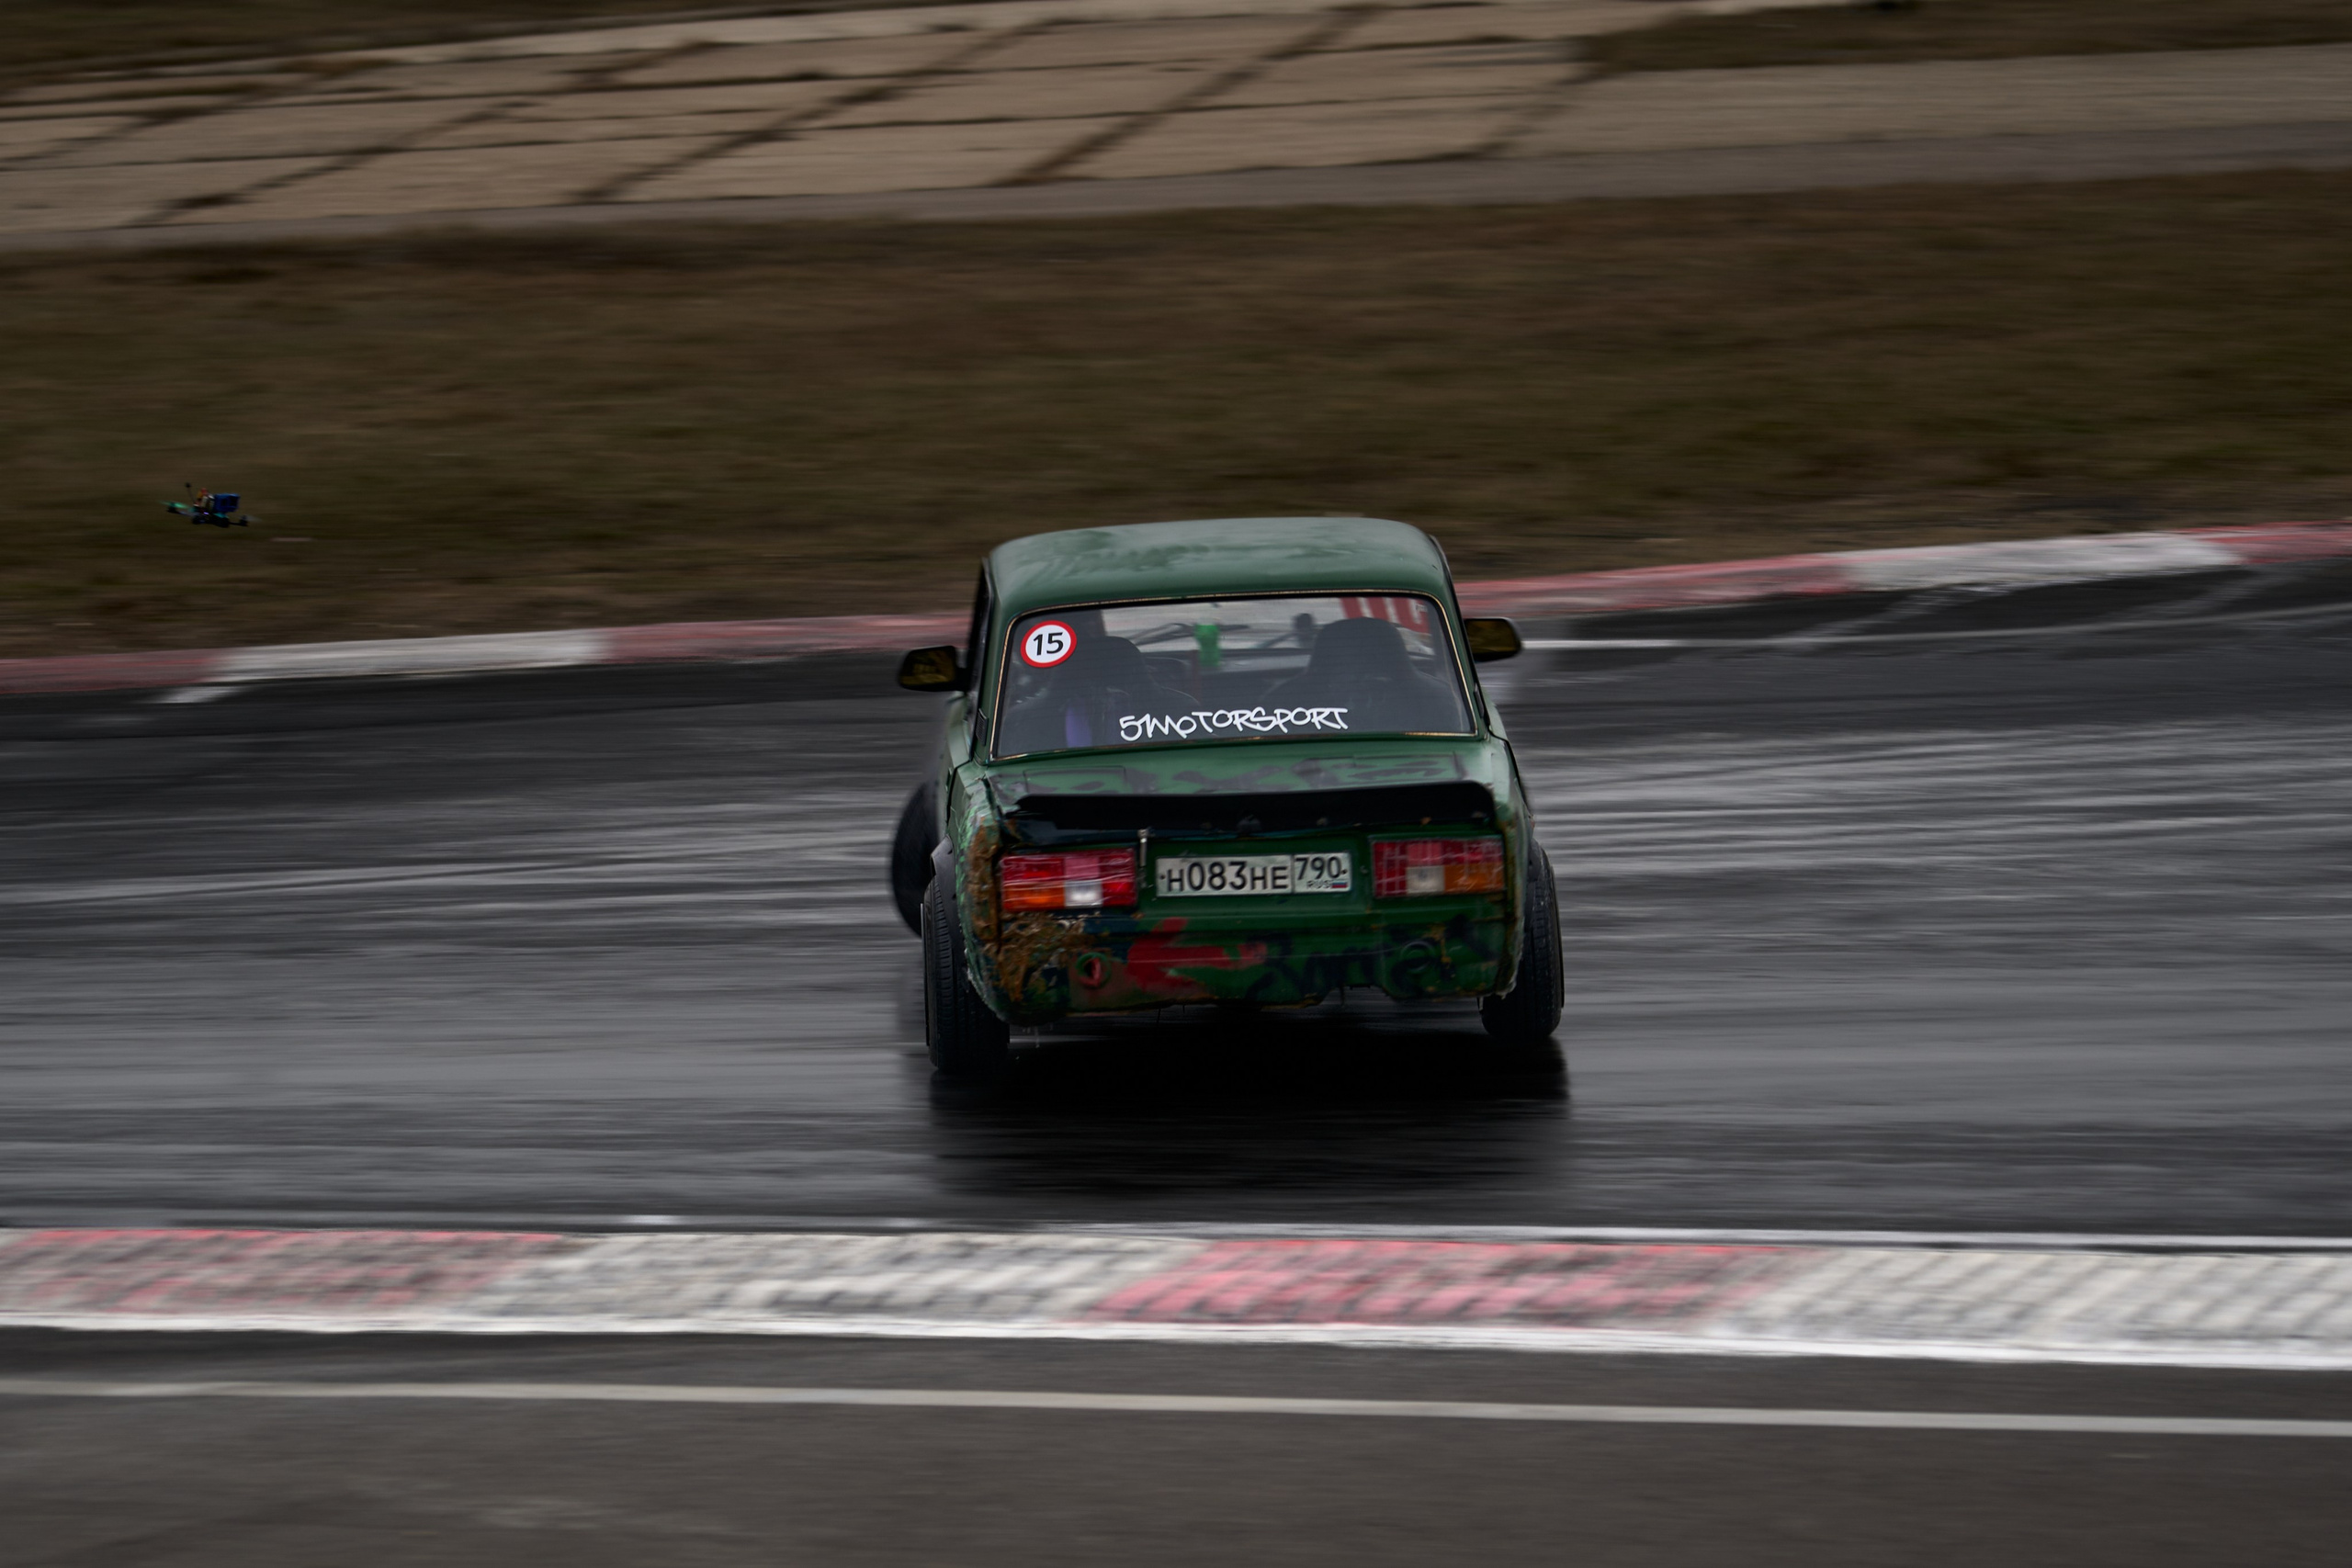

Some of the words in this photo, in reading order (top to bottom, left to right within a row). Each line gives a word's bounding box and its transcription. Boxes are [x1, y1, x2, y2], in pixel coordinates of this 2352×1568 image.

[1033, 632, 1064, 656] 15
[1167, 862, 1288, 892] H083HE
[1295, 856, 1342, 880] 790
[1306, 879, 1332, 890] RUS
